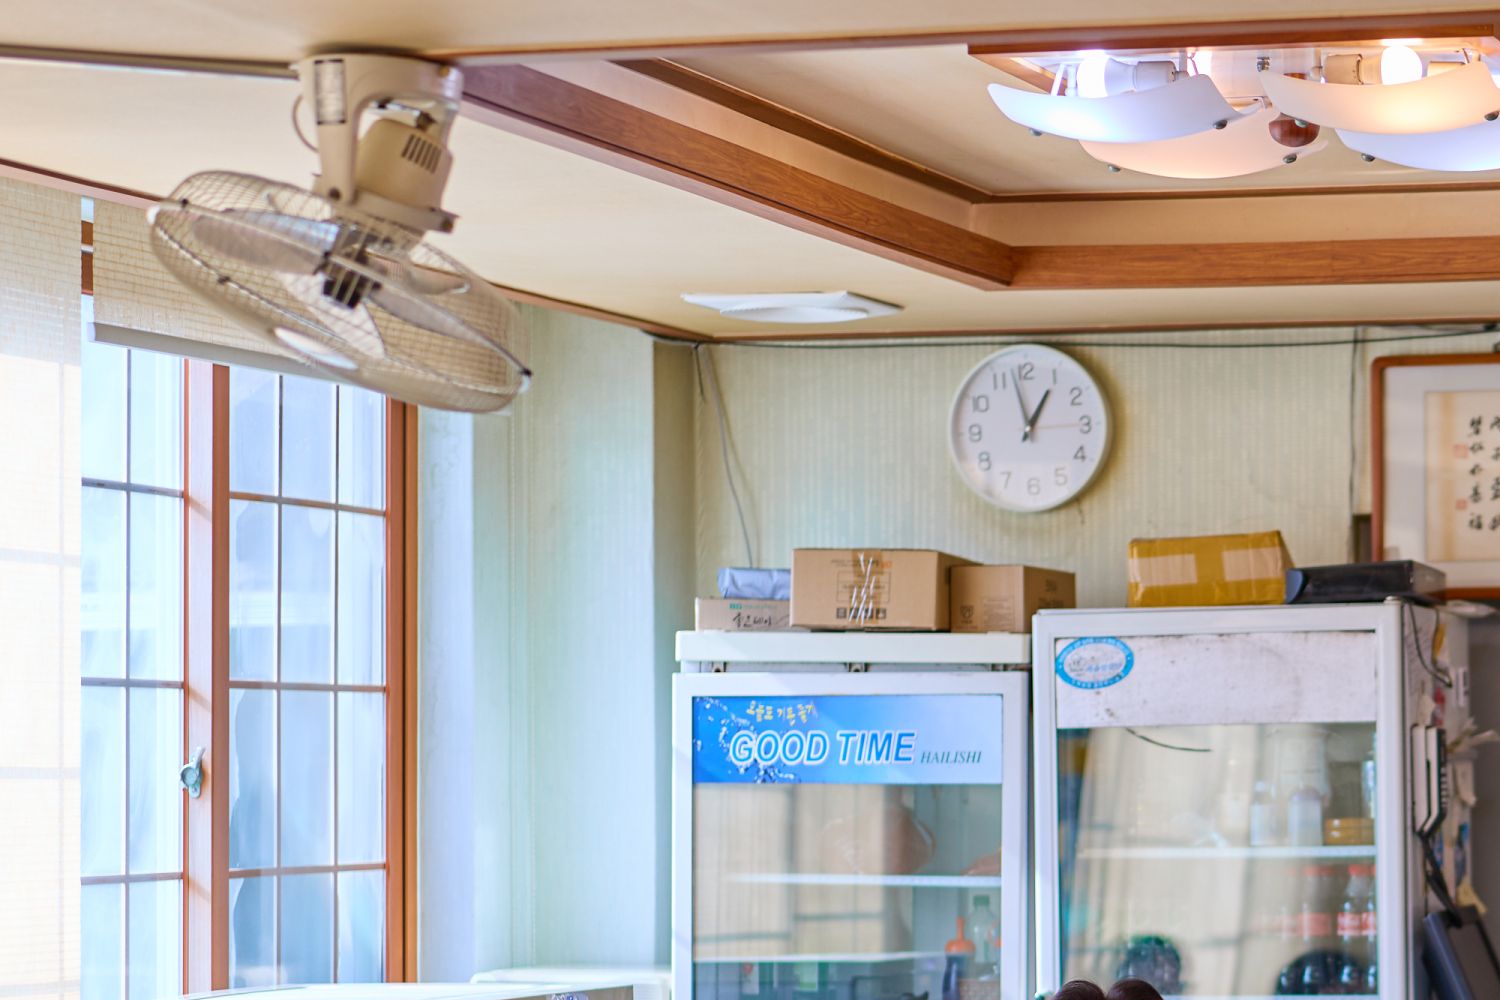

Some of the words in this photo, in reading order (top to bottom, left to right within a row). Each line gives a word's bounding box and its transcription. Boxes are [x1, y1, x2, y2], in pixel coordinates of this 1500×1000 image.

[993, 371, 1007, 390] 11
[1018, 362, 1035, 381] 12
[972, 395, 990, 413] 10
[1069, 387, 1083, 406] 2
[968, 424, 982, 443] 9
[1079, 415, 1092, 434] 3
[978, 451, 992, 471] 8
[1073, 446, 1087, 462] 4
[1000, 471, 1012, 489] 7
[1055, 467, 1068, 486] 5
[1027, 478, 1041, 495] 6
[730, 729, 830, 766] GOOD
[837, 729, 917, 765] TIME
[920, 751, 982, 764] HAILISHI
